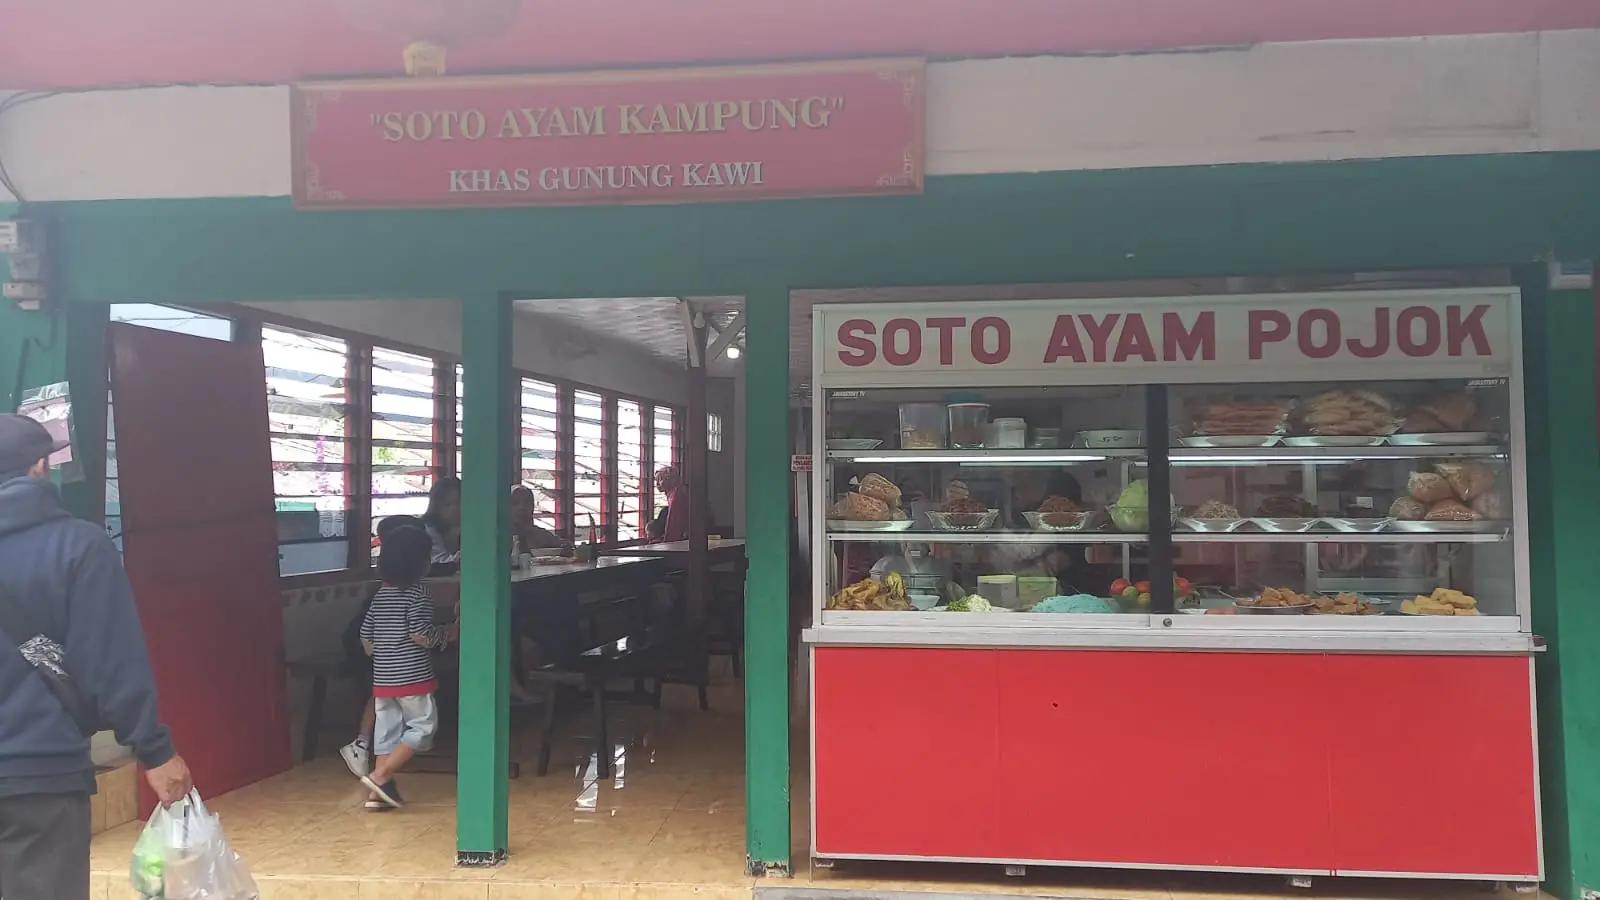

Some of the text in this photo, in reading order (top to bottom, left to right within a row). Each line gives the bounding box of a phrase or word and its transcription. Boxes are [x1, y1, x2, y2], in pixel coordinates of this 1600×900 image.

[370, 96, 845, 142] "SOTO AYAM KAMPUNG"
[447, 160, 764, 193] KHAS GUNUNG KAWI
[837, 304, 1492, 367] SOTO AYAM POJOK
